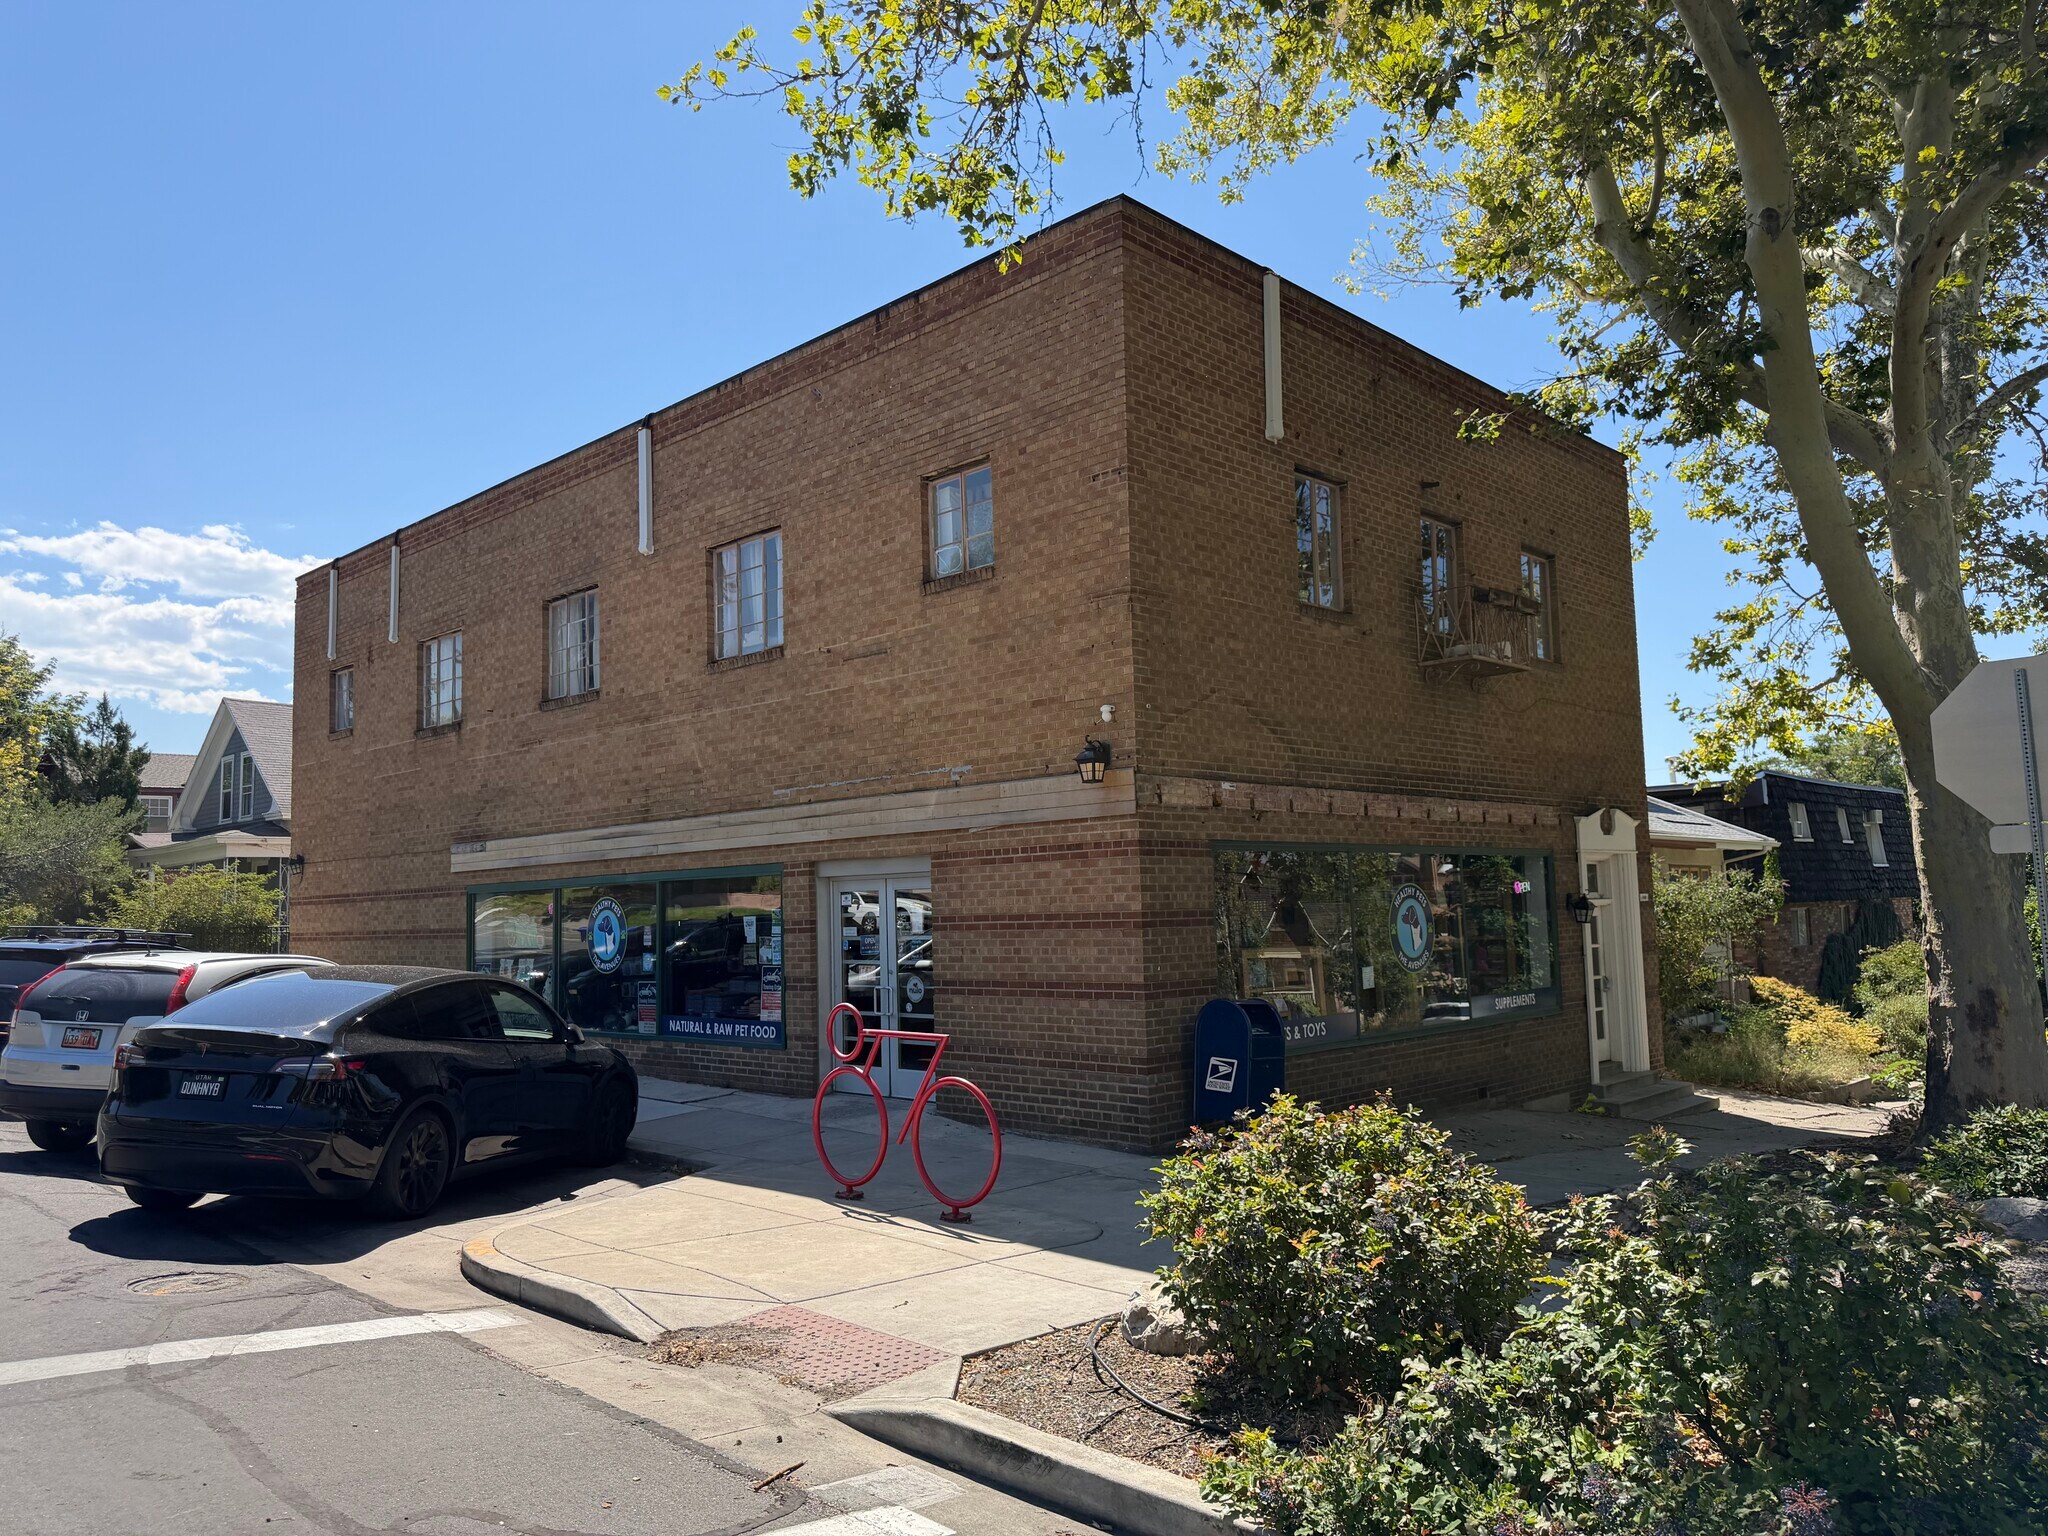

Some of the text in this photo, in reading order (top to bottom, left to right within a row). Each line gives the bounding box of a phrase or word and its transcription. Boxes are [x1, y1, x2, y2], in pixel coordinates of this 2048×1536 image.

[1514, 881, 1530, 893] OPEN
[1394, 887, 1427, 907] HEALTHY PETS
[592, 900, 621, 918] HEALTHY PETS
[600, 954, 620, 970] AVENUES
[1399, 950, 1429, 969] THE AVENUES
[1495, 993, 1536, 1010] SUPPLEMENTS
[669, 1020, 704, 1034] NATURAL
[706, 1023, 712, 1034] &
[714, 1022, 733, 1036] RAW
[735, 1024, 748, 1037] PET
[750, 1025, 776, 1038] FOOD
[1294, 1026, 1301, 1039] &
[1303, 1021, 1326, 1038] TOYS
